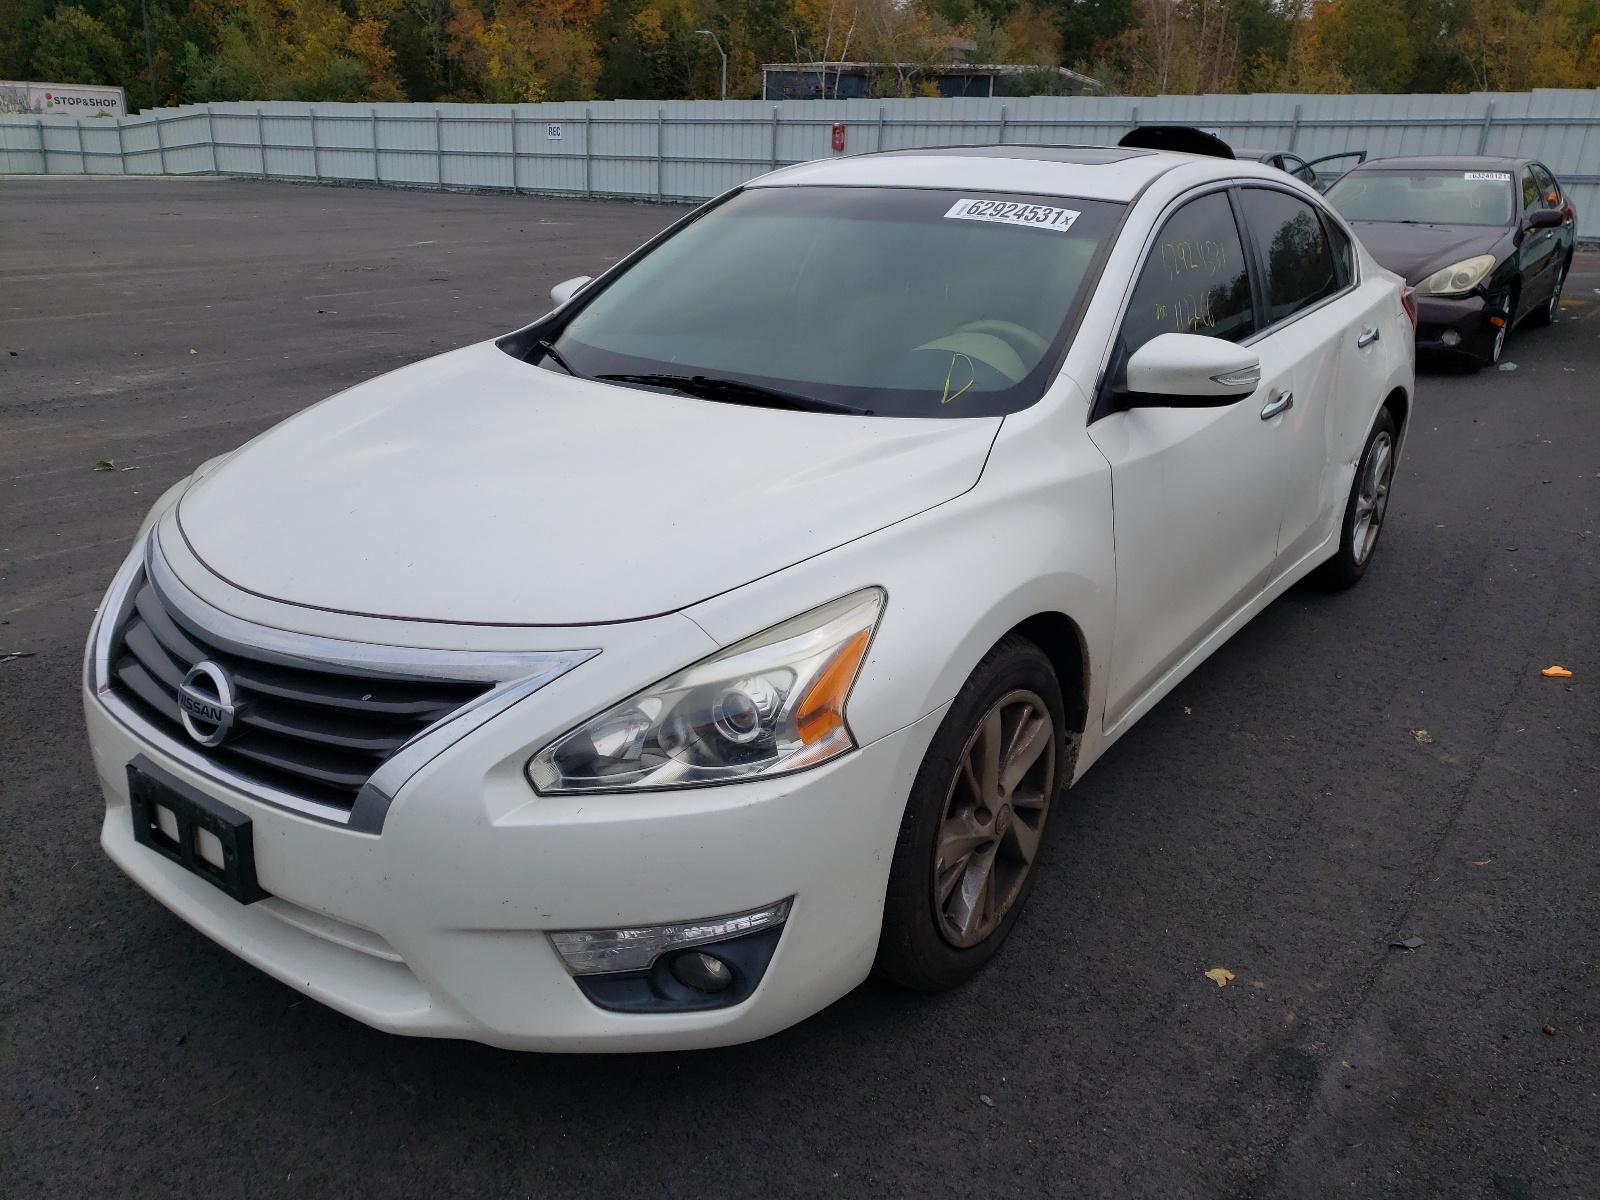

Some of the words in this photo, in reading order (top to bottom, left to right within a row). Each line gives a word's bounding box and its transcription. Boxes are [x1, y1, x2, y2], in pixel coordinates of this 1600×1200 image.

[53, 96, 117, 108] STOP&SHOP
[548, 126, 561, 137] REC
[966, 200, 1065, 225] 62924531
[179, 691, 222, 722] NISSAN
